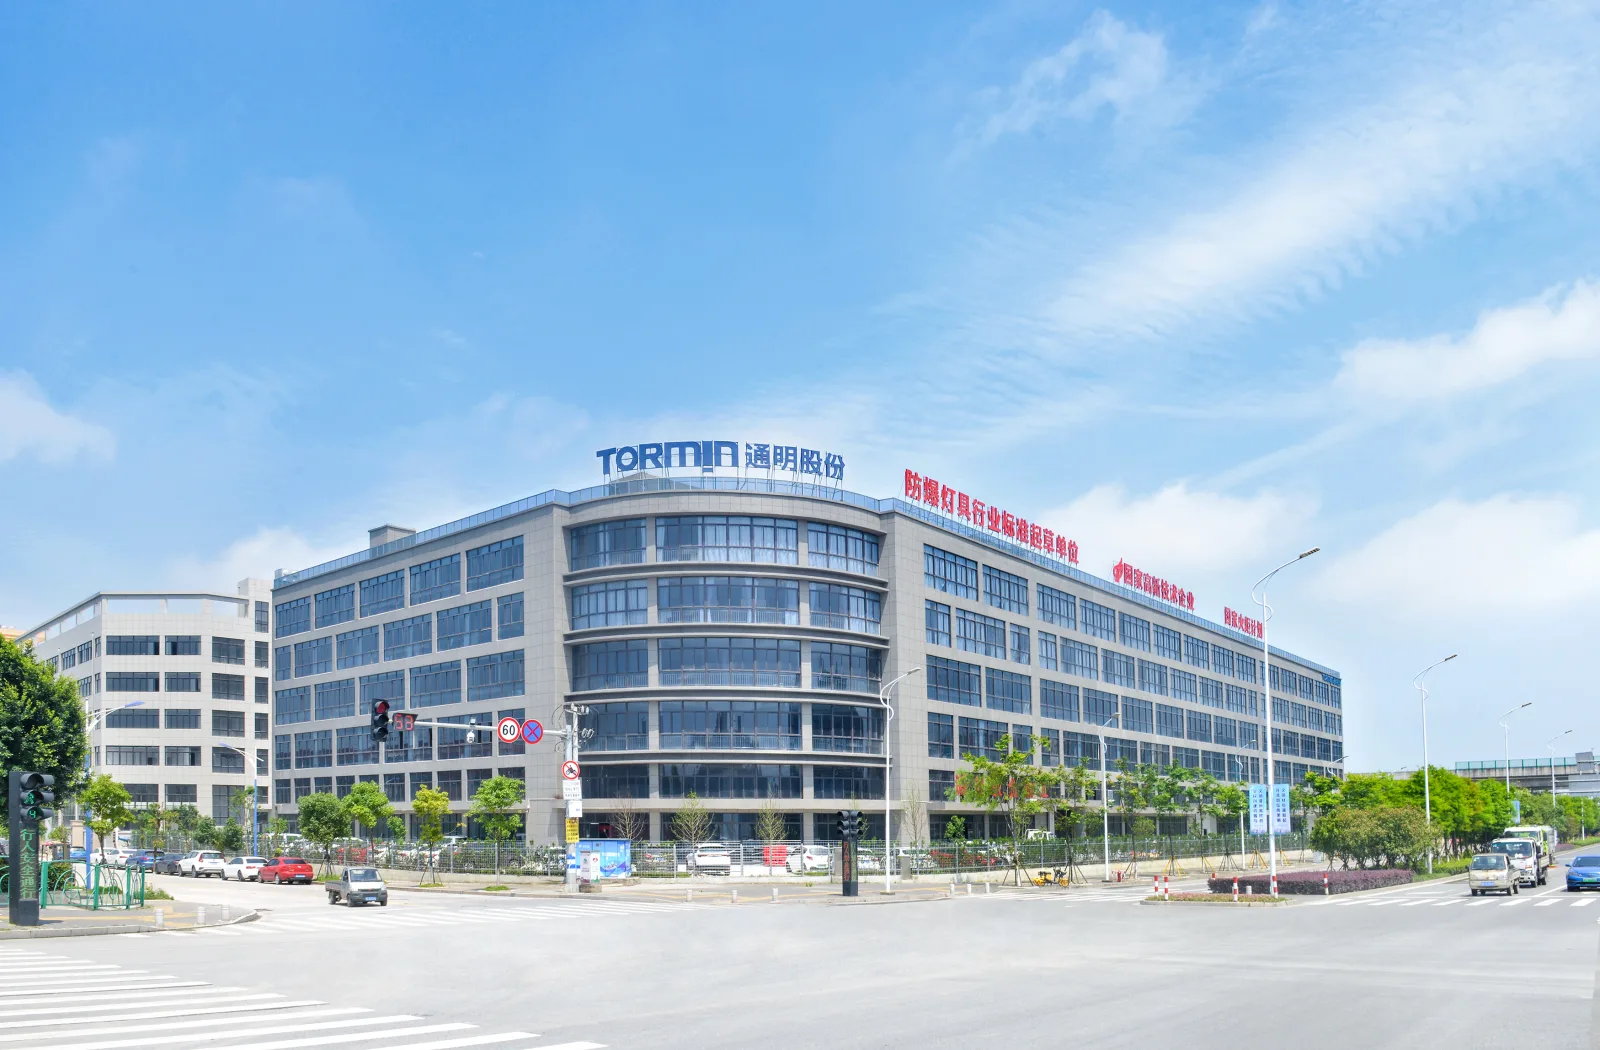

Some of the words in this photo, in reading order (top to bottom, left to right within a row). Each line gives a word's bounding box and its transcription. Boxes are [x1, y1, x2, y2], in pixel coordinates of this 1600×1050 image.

[596, 440, 739, 475] TORMIN
[745, 442, 845, 480] 通明股份
[904, 468, 1079, 564] 防爆灯具行业标准起草单位
[1123, 562, 1195, 611] 国家高新技术企业
[395, 713, 414, 731] 53
[502, 724, 516, 736] 60
[21, 829, 36, 899] 行人安全通行
